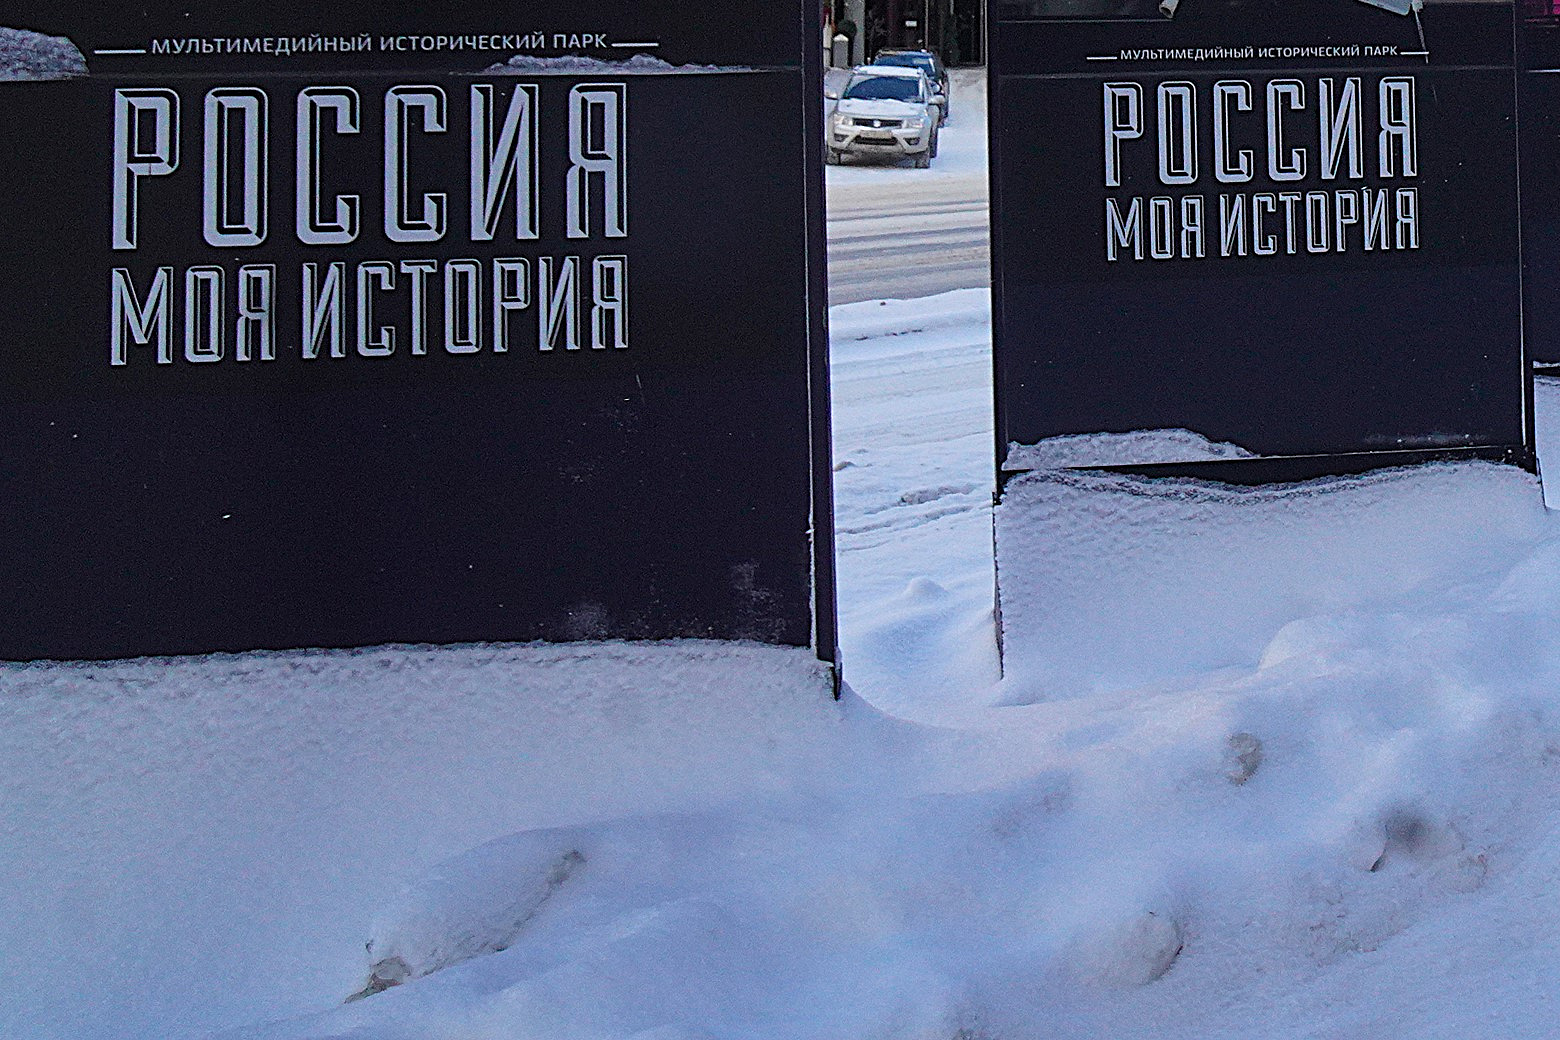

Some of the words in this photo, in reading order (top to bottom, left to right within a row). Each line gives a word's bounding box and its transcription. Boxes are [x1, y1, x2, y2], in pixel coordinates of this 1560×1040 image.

[151, 32, 372, 56] МУЛЬТИМЕДИЙНЫЙ
[380, 30, 546, 52] ИСТОРИЧЕСКИЙ
[552, 33, 607, 49] ПАРК
[1120, 46, 1254, 61] МУЛЬТИМЕДИЙНЫЙ
[1258, 44, 1360, 59] ИСТОРИЧЕСКИЙ
[1364, 45, 1398, 57] ПАРК
[112, 83, 628, 250] РОССИЯ
[1103, 76, 1418, 187] РОССИЯ
[1106, 195, 1206, 261] МОЯ
[1219, 187, 1420, 257] ИСТОРИЯ
[110, 264, 277, 366] МОЯ
[301, 255, 629, 359] ИСТОРИЯ
